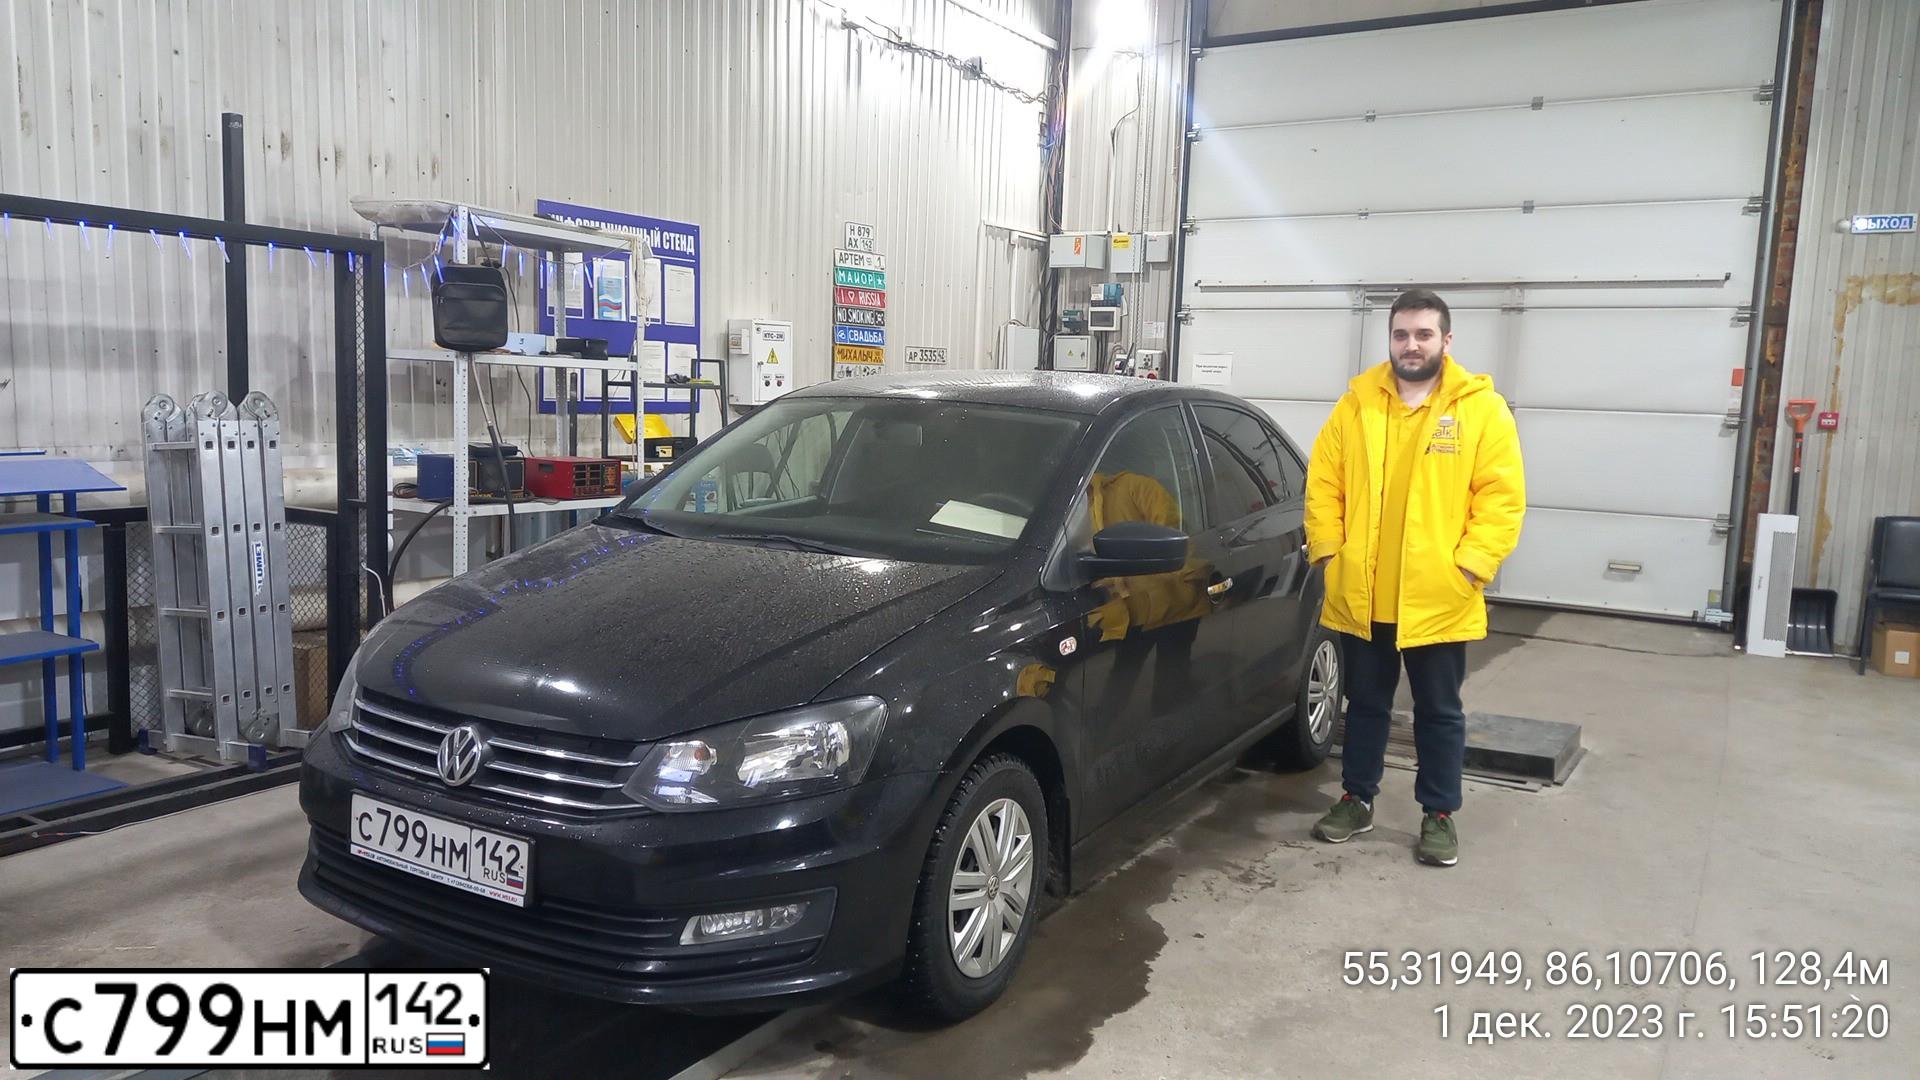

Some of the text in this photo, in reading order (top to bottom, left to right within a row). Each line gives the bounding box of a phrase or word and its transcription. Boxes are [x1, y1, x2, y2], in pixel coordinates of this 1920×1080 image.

[1856, 217, 1910, 230] ЫХОД
[548, 213, 695, 256] АЦИОННЫЙ СТЕНД
[850, 225, 870, 237] Н 879
[848, 237, 872, 249] АХ 142
[839, 252, 864, 266] АРТЕМ
[859, 291, 881, 306] RUSSIA
[837, 307, 875, 324] NO SMOKING
[849, 329, 884, 343] СВАДЬБА
[836, 348, 873, 362] МИХАЛЫЧ
[909, 351, 918, 361] АР
[919, 349, 937, 361] 3535
[358, 807, 520, 877] С799НМ 142
[483, 867, 506, 884] RUS
